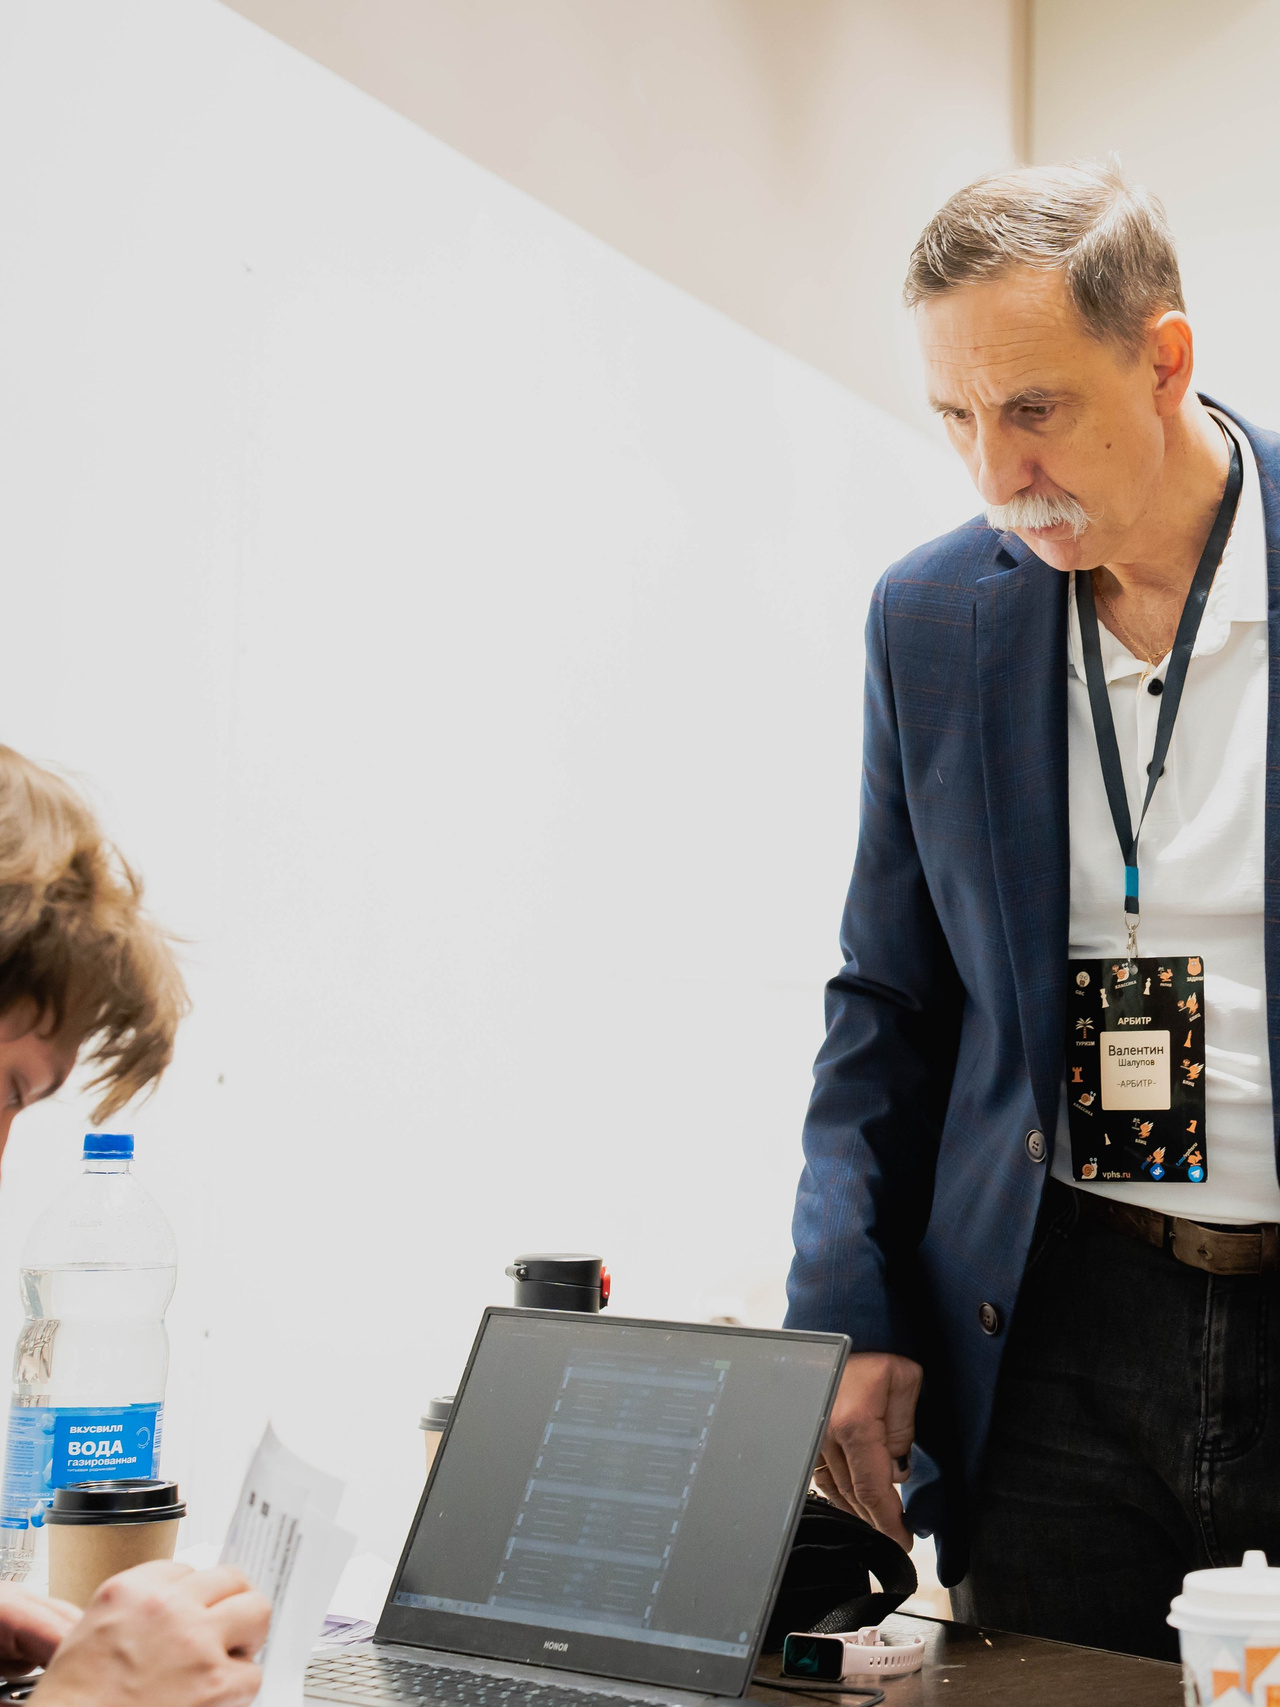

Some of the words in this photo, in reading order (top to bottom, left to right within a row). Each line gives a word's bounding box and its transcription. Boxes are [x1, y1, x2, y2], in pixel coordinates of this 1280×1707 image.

[1118, 1017, 1152, 1025] АРБИТР
[1108, 1045, 1164, 1056] Валентин
[1118, 1059, 1155, 1068] Шалупов
[1102, 1170, 1131, 1180] vphs.ru
[69, 1424, 123, 1434] ВКУСВИЛЛ
[67, 1439, 124, 1458] ВОДА
[67, 1456, 137, 1468] газированная
[543, 1640, 569, 1652] HONOR
